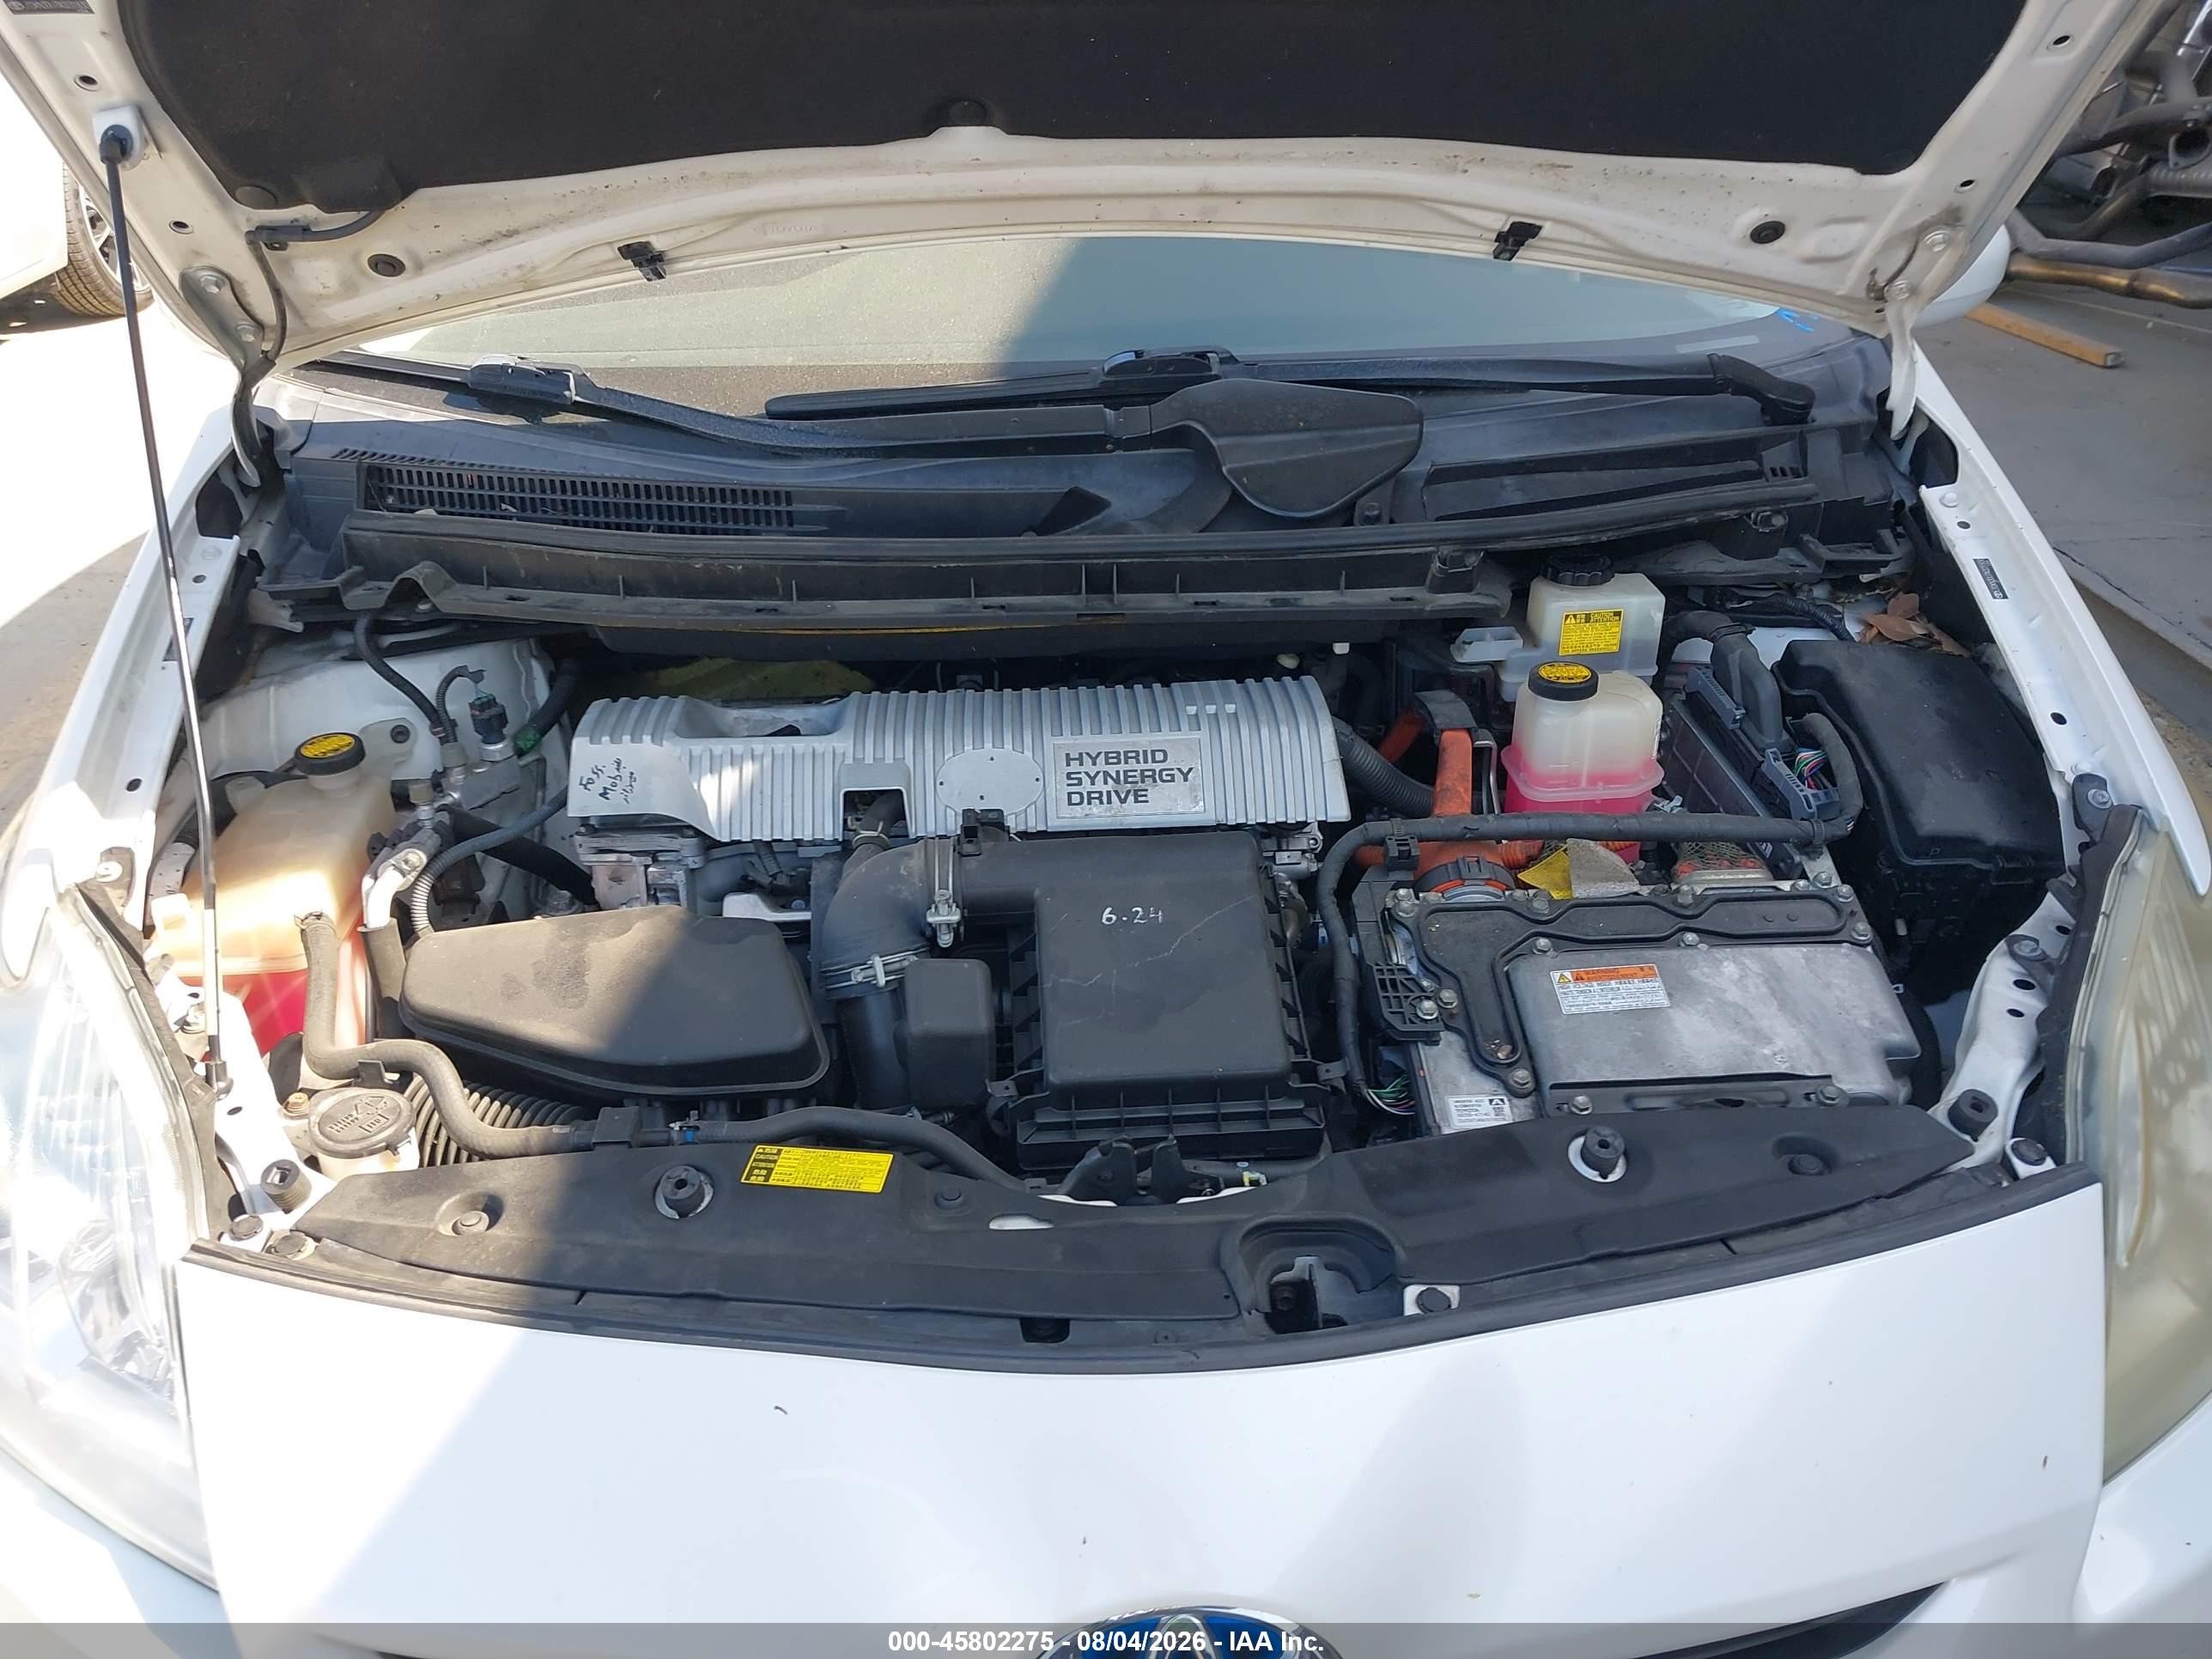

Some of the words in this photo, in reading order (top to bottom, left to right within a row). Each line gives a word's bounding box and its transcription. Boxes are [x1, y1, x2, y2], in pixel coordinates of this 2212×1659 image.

[1065, 749, 1169, 767] HYBRID
[1066, 767, 1194, 787] SYNERGY
[1066, 788, 1150, 806] DRIVE
